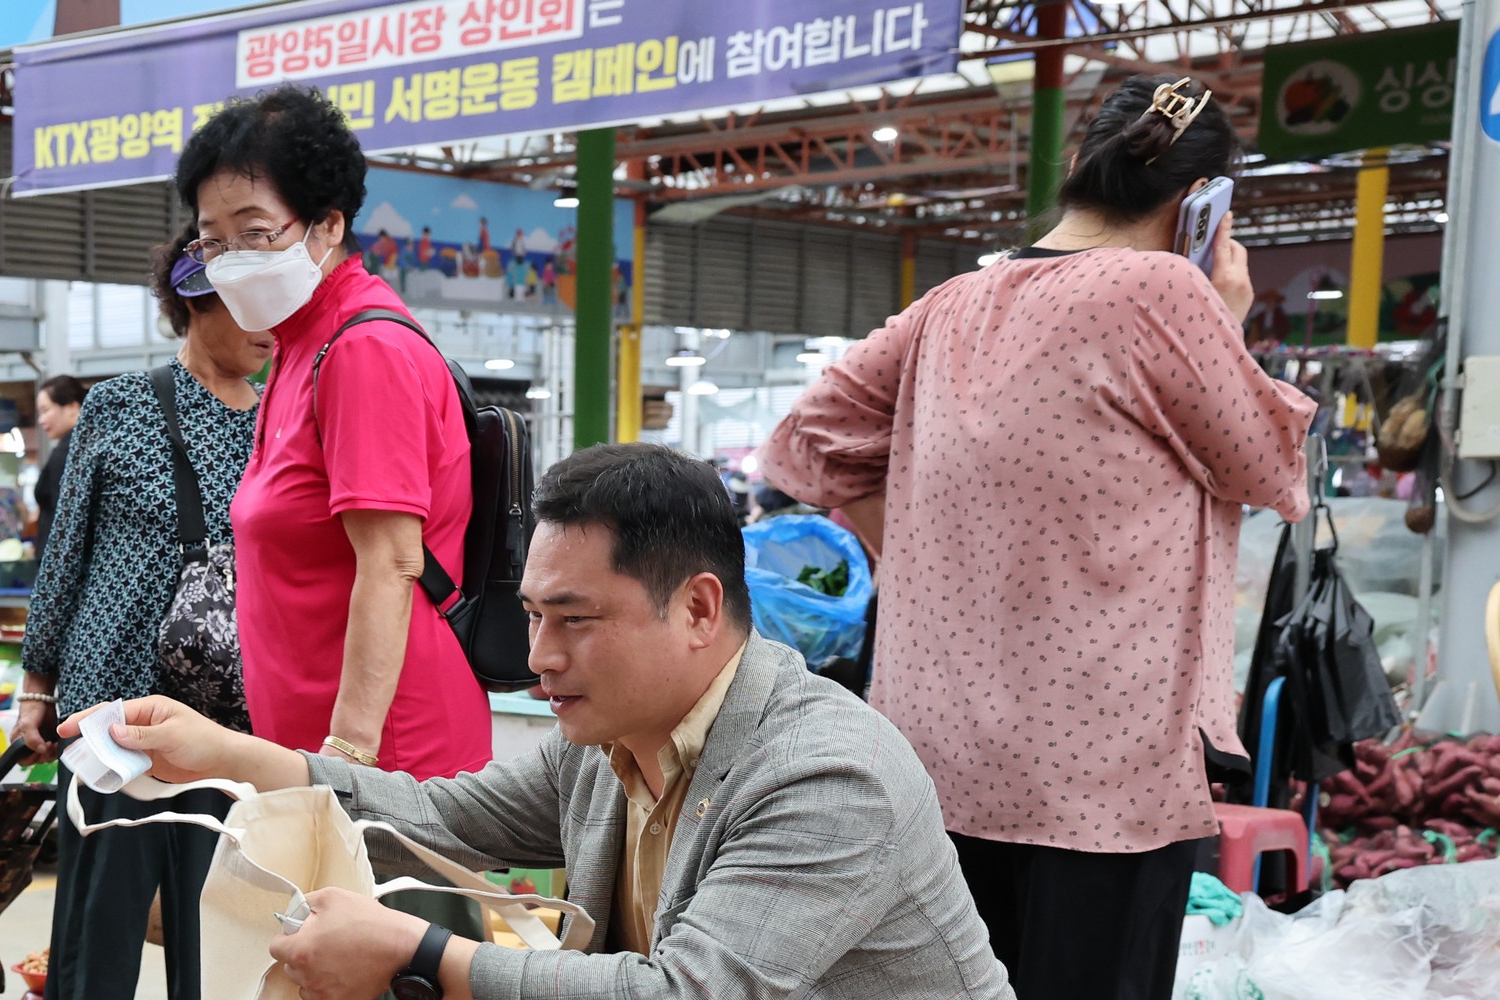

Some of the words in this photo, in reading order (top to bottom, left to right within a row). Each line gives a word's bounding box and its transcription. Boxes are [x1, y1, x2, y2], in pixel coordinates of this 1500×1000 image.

[34, 107, 183, 170] KTX광양역
[384, 56, 540, 123] 서명운동
[551, 36, 716, 104] 캠페인에
[725, 2, 929, 79] 참여합니다
[246, 7, 446, 79] 광양5일시장
